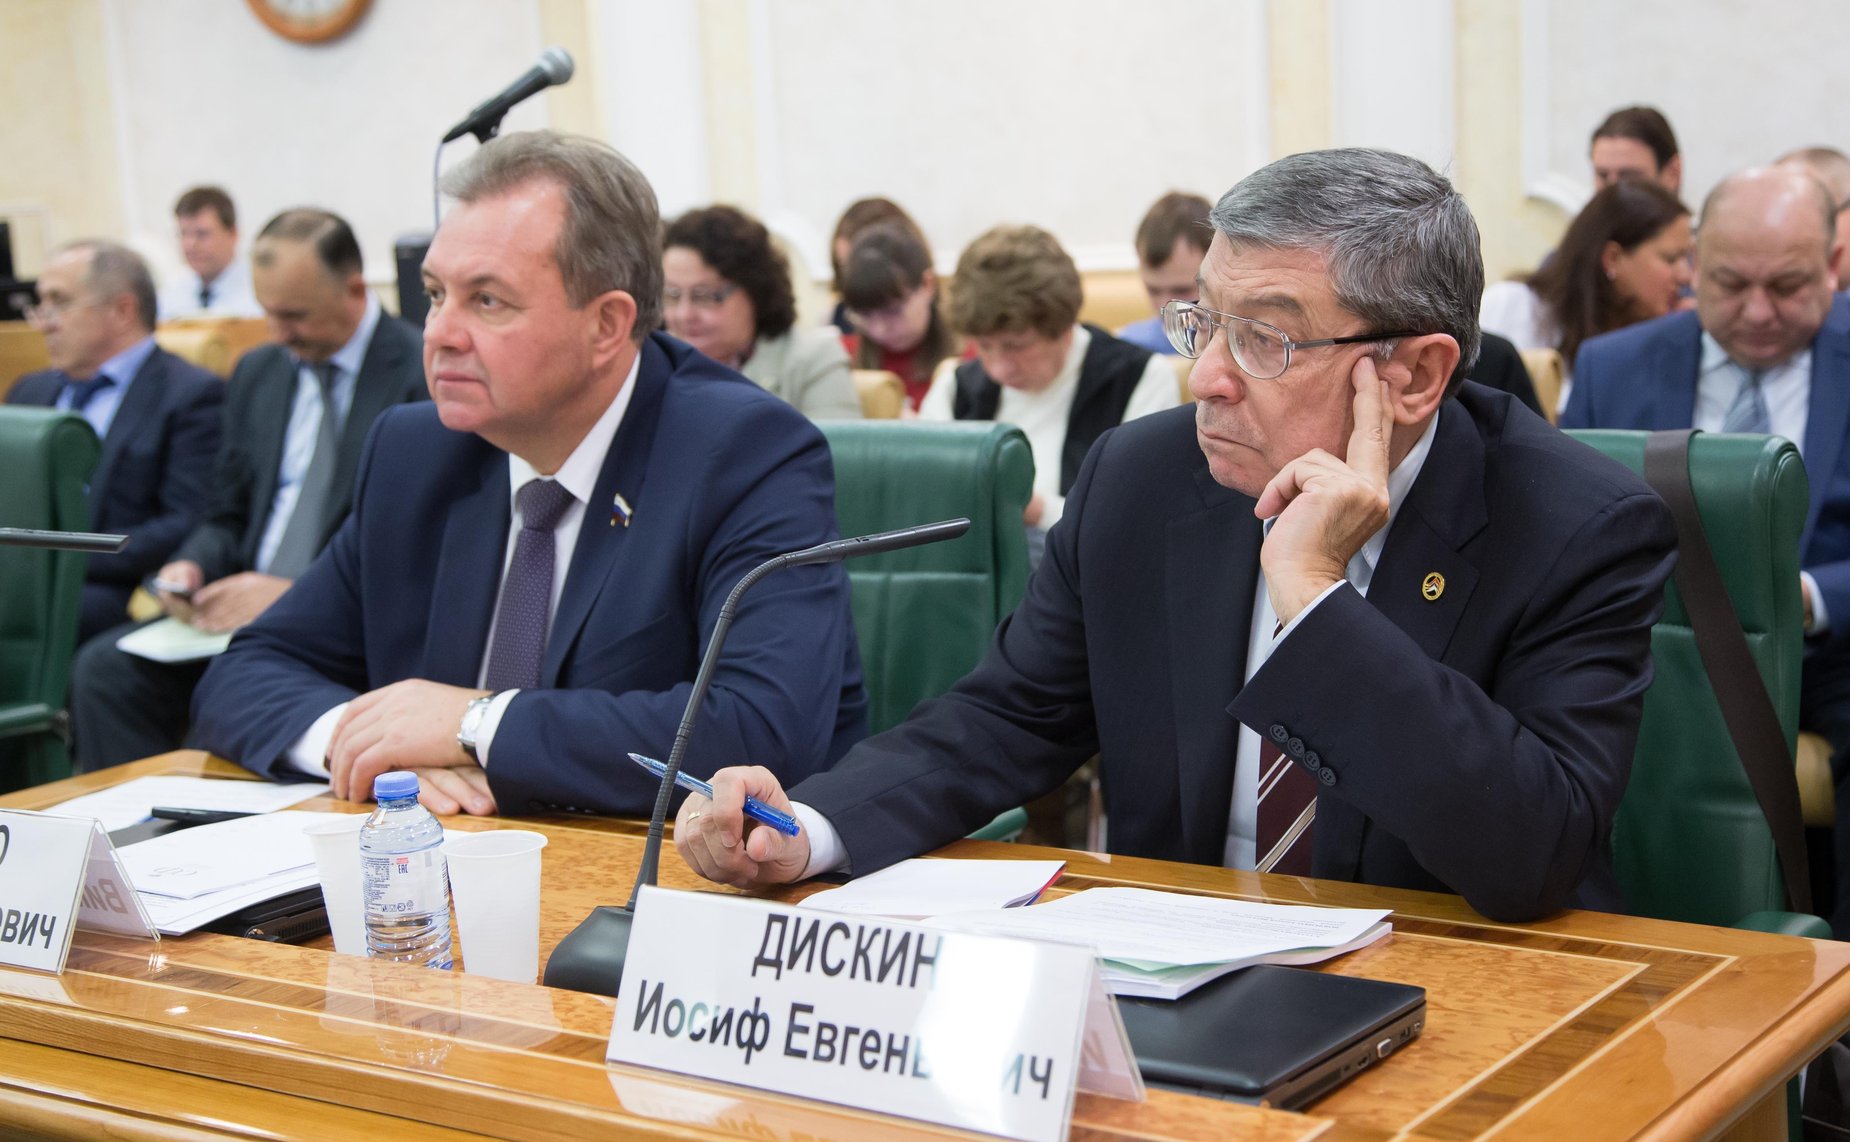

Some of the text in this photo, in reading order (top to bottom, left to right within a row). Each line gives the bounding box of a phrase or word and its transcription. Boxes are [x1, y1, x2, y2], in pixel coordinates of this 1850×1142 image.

[0, 907, 57, 950] вич
[751, 913, 944, 991] ДИСКИН
[633, 979, 770, 1065] Иосиф
[783, 1002, 1053, 1100] Евгеньич
